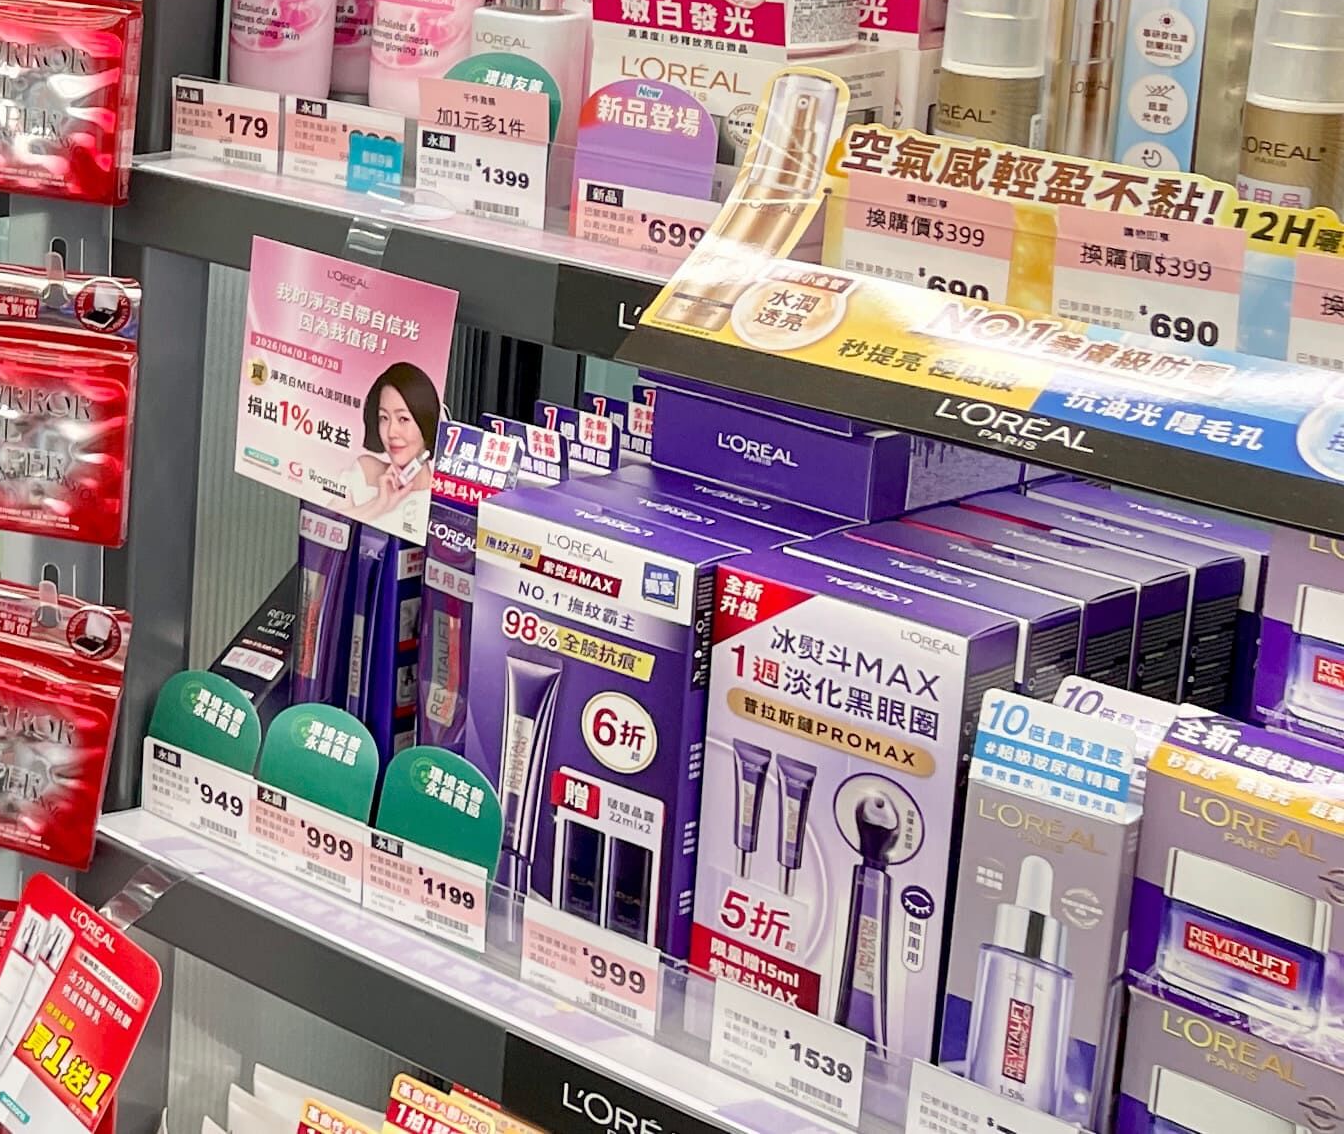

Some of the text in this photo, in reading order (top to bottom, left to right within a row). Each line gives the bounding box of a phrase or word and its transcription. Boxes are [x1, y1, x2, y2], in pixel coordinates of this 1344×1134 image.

[280, 28, 300, 41] skin
[436, 106, 526, 137] 加1元多1件
[596, 93, 703, 137] 新品登場
[841, 127, 1226, 229] 空氣感輕盈不黏!
[865, 208, 986, 250] 換購價$399
[1080, 241, 1213, 282] 換購價$399
[275, 281, 421, 341] 我的淨亮自帶自信光
[753, 306, 808, 333] 透亮
[768, 288, 822, 315] 水潤
[298, 313, 389, 356] 因為我值得!
[837, 337, 920, 373] 秒提亮
[316, 420, 352, 449] 收益
[935, 398, 1094, 454] L'ORÉAL
[977, 427, 1037, 451] PARIS
[1063, 389, 1265, 450] 抗油光 隱毛孔
[717, 431, 799, 468] L'ORÉAL
[300, 516, 345, 543] 試用品
[547, 532, 614, 563] L'ORÉAL
[518, 580, 561, 606] NO.1
[541, 558, 614, 595] 紫熨斗MAX
[722, 574, 765, 603] 全新
[719, 593, 760, 622] 升級
[503, 609, 559, 652] 98%
[769, 625, 941, 702] 冰熨斗MAX
[729, 643, 940, 741] 1週淡化黑眼圈
[592, 707, 648, 754] 6折
[1171, 717, 1241, 755] 全新
[562, 777, 592, 814] 贈
[977, 797, 1109, 857] L'ORÉAL
[1178, 789, 1327, 863] L'ORÉAL
[719, 888, 792, 949] 5折
[1188, 926, 1293, 974] REVITALIFT
[21, 1019, 113, 1114] 買1送1
[1161, 1009, 1306, 1087] L'ORÉAL
